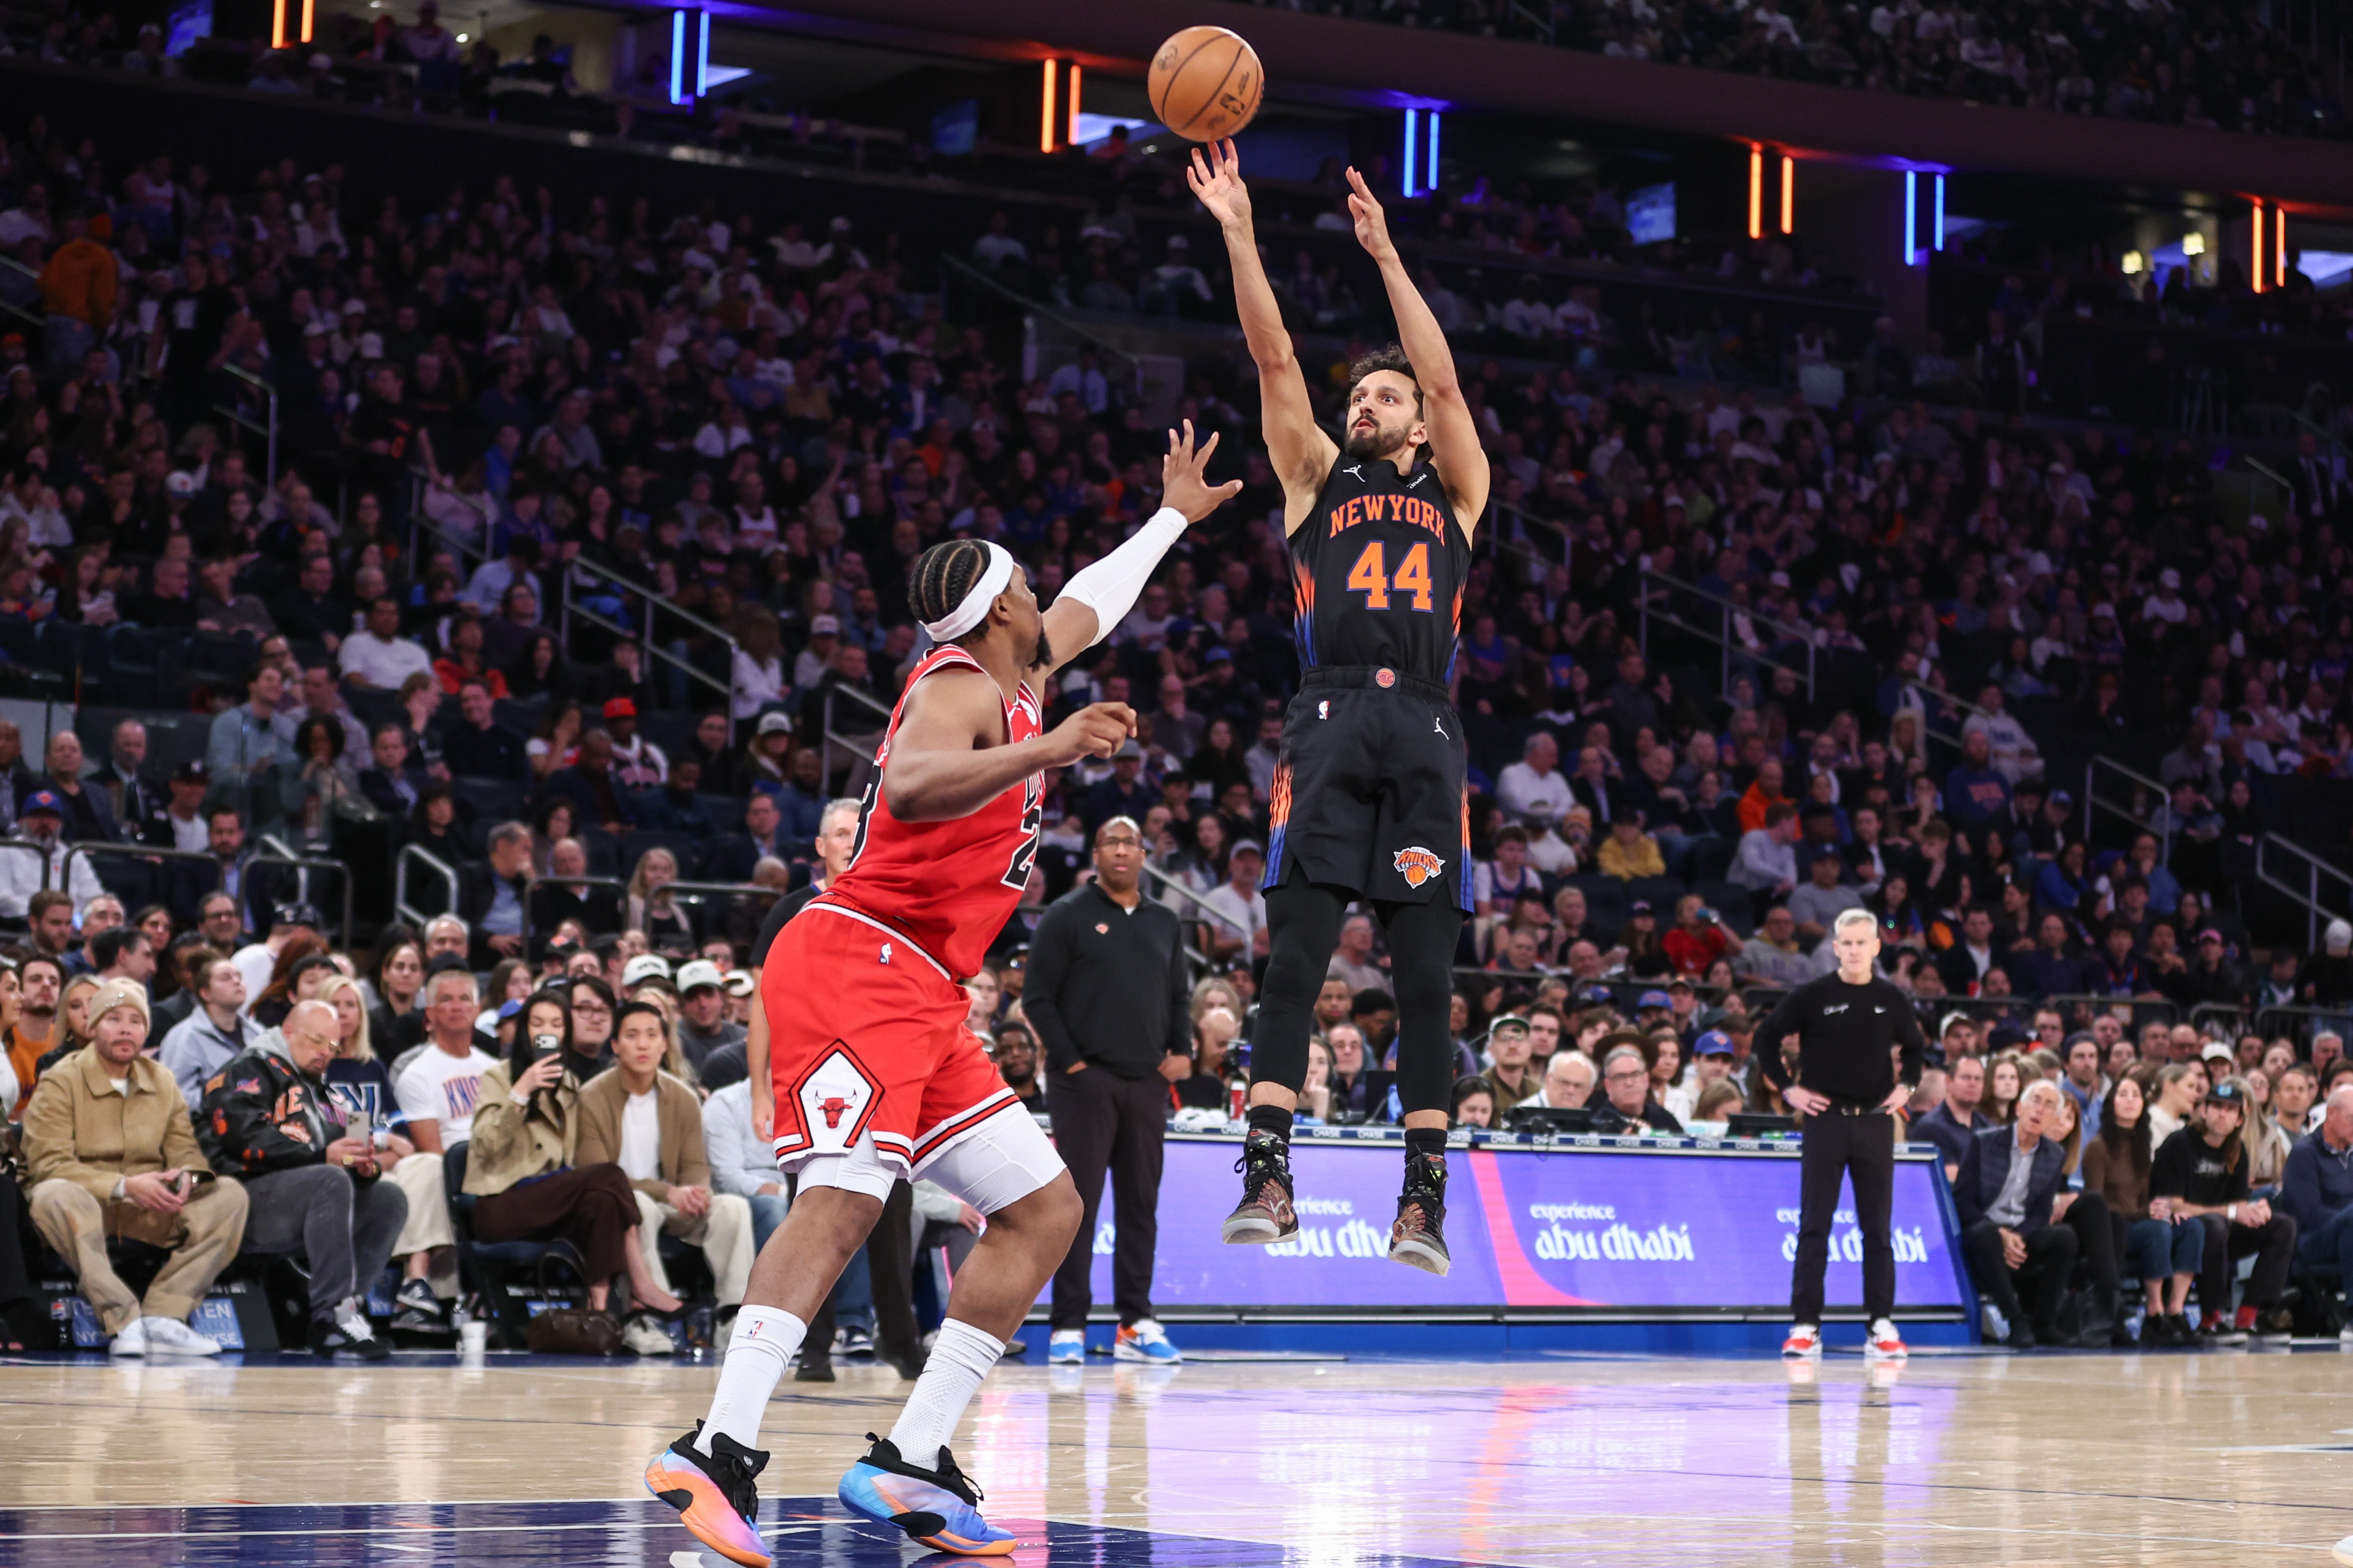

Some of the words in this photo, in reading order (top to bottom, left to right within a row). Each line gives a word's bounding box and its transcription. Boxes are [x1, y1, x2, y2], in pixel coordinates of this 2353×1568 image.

[1330, 495, 1386, 539] NEW
[1388, 494, 1445, 547] YORK
[1346, 540, 1434, 613] 44
[1396, 851, 1439, 872] KNICKS
[1530, 1201, 1616, 1223] experience
[1536, 1223, 1600, 1260] abu
[1601, 1223, 1695, 1261] dhabi
